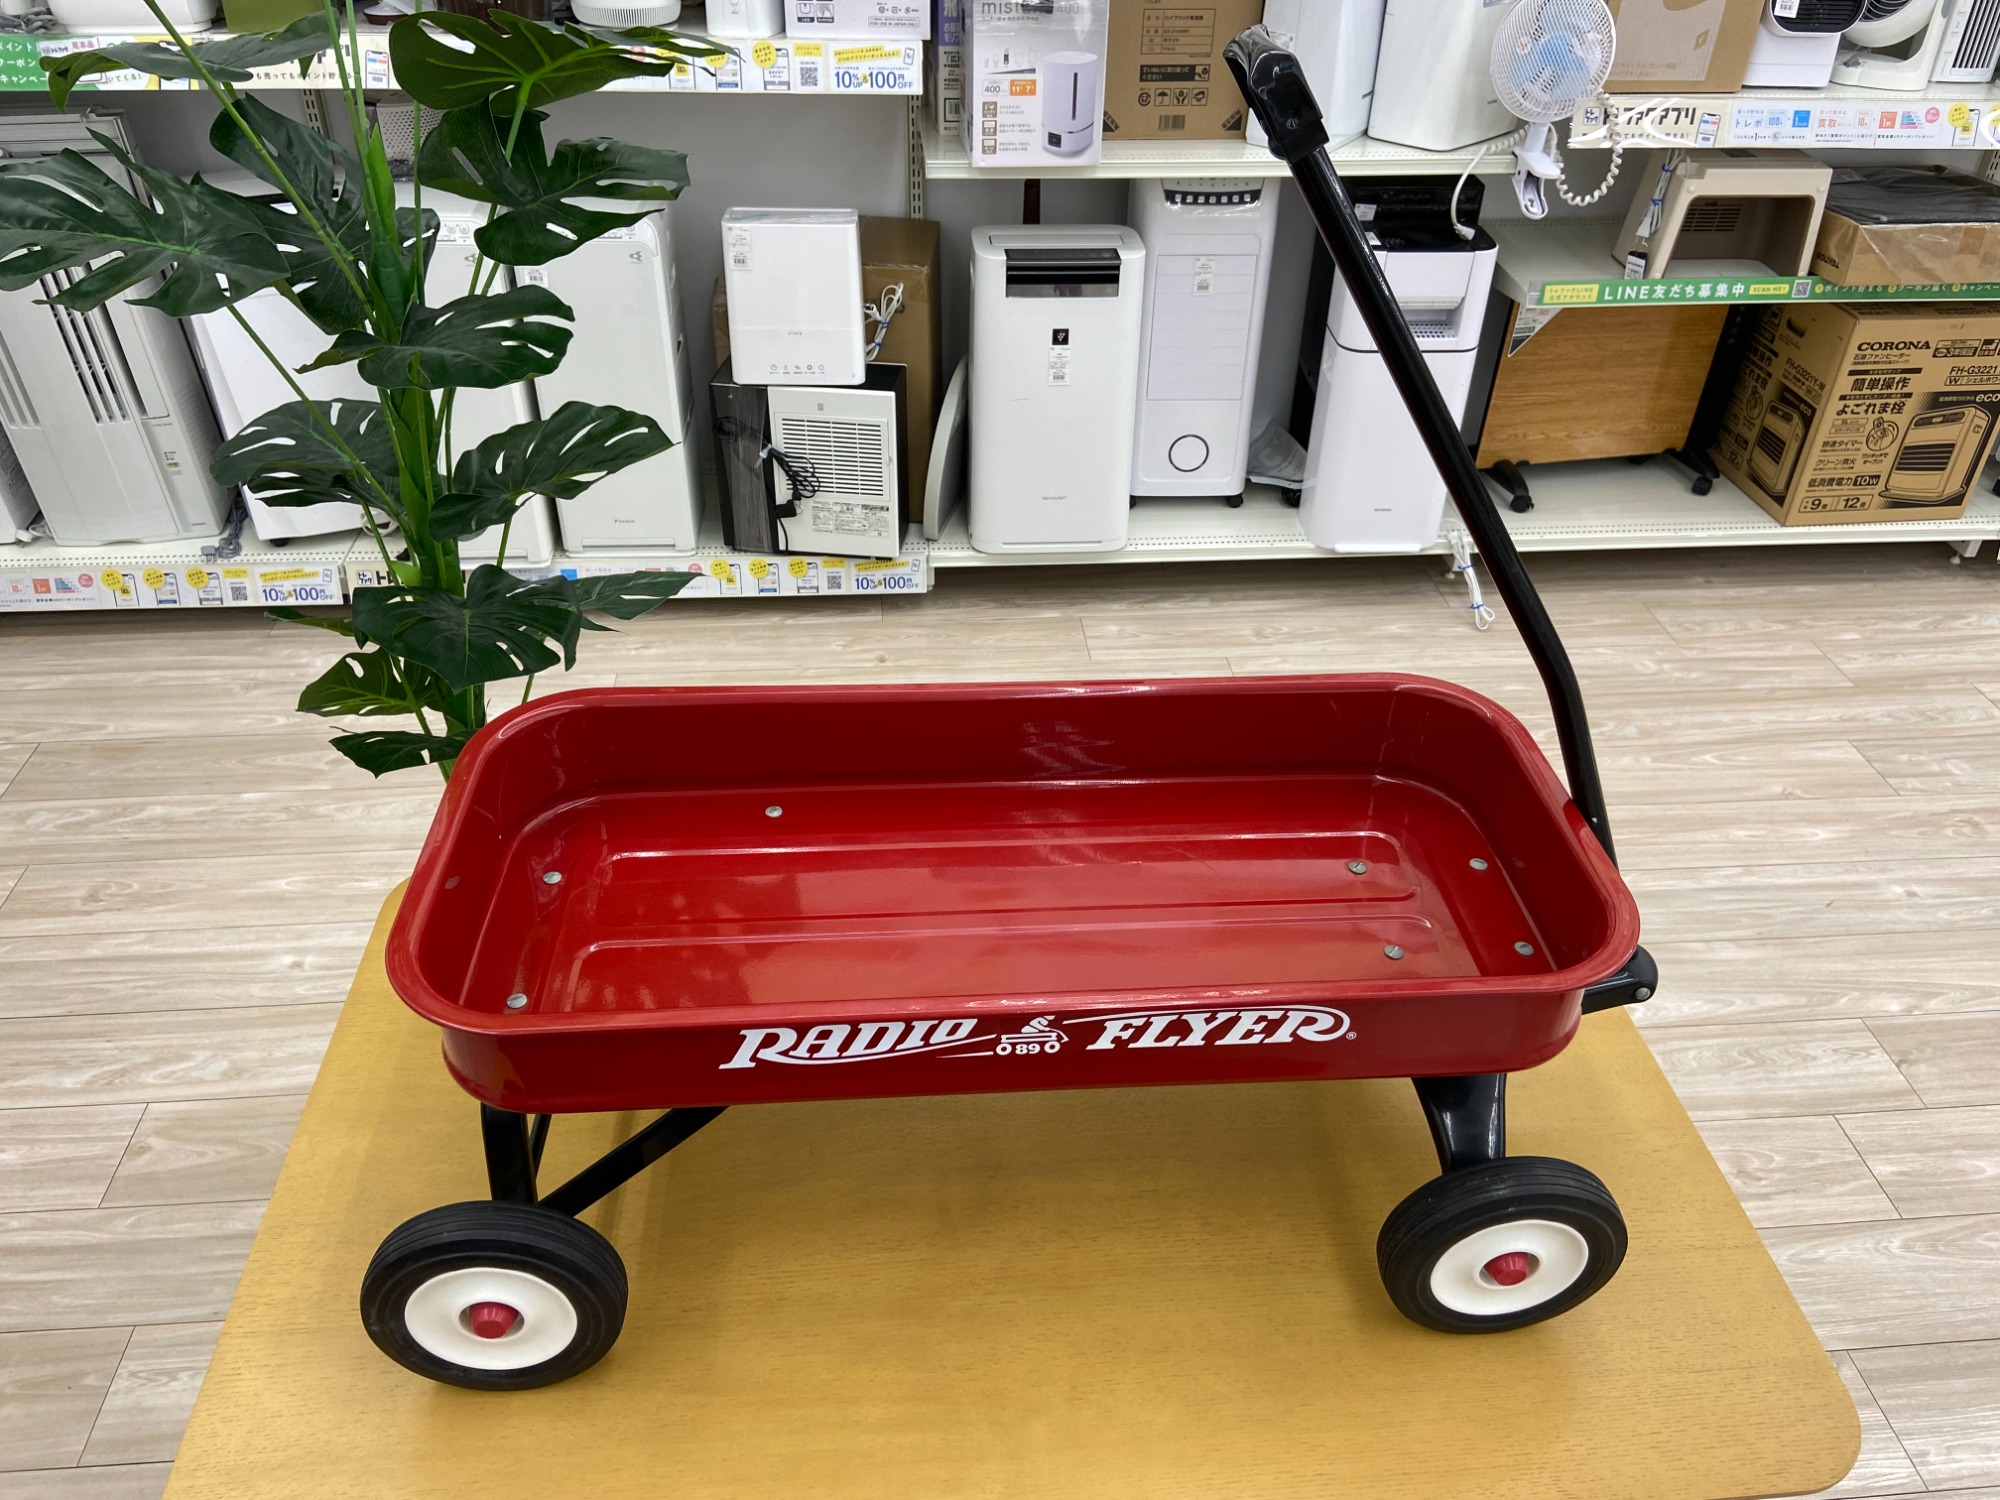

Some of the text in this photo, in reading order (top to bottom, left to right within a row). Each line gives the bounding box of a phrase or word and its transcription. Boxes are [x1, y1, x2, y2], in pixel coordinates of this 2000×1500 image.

[1604, 283, 1745, 300] LINE友だち募集中
[1857, 340, 1931, 351] CORONA
[1949, 365, 2000, 376] FH-G3221
[1851, 377, 1911, 393] 簡単操作
[1965, 376, 2000, 384] シェルホワ
[1836, 400, 1906, 416] よごれま栓
[719, 1005, 1352, 1069] RADIO FLYER
[1015, 1043, 1041, 1055] 89
